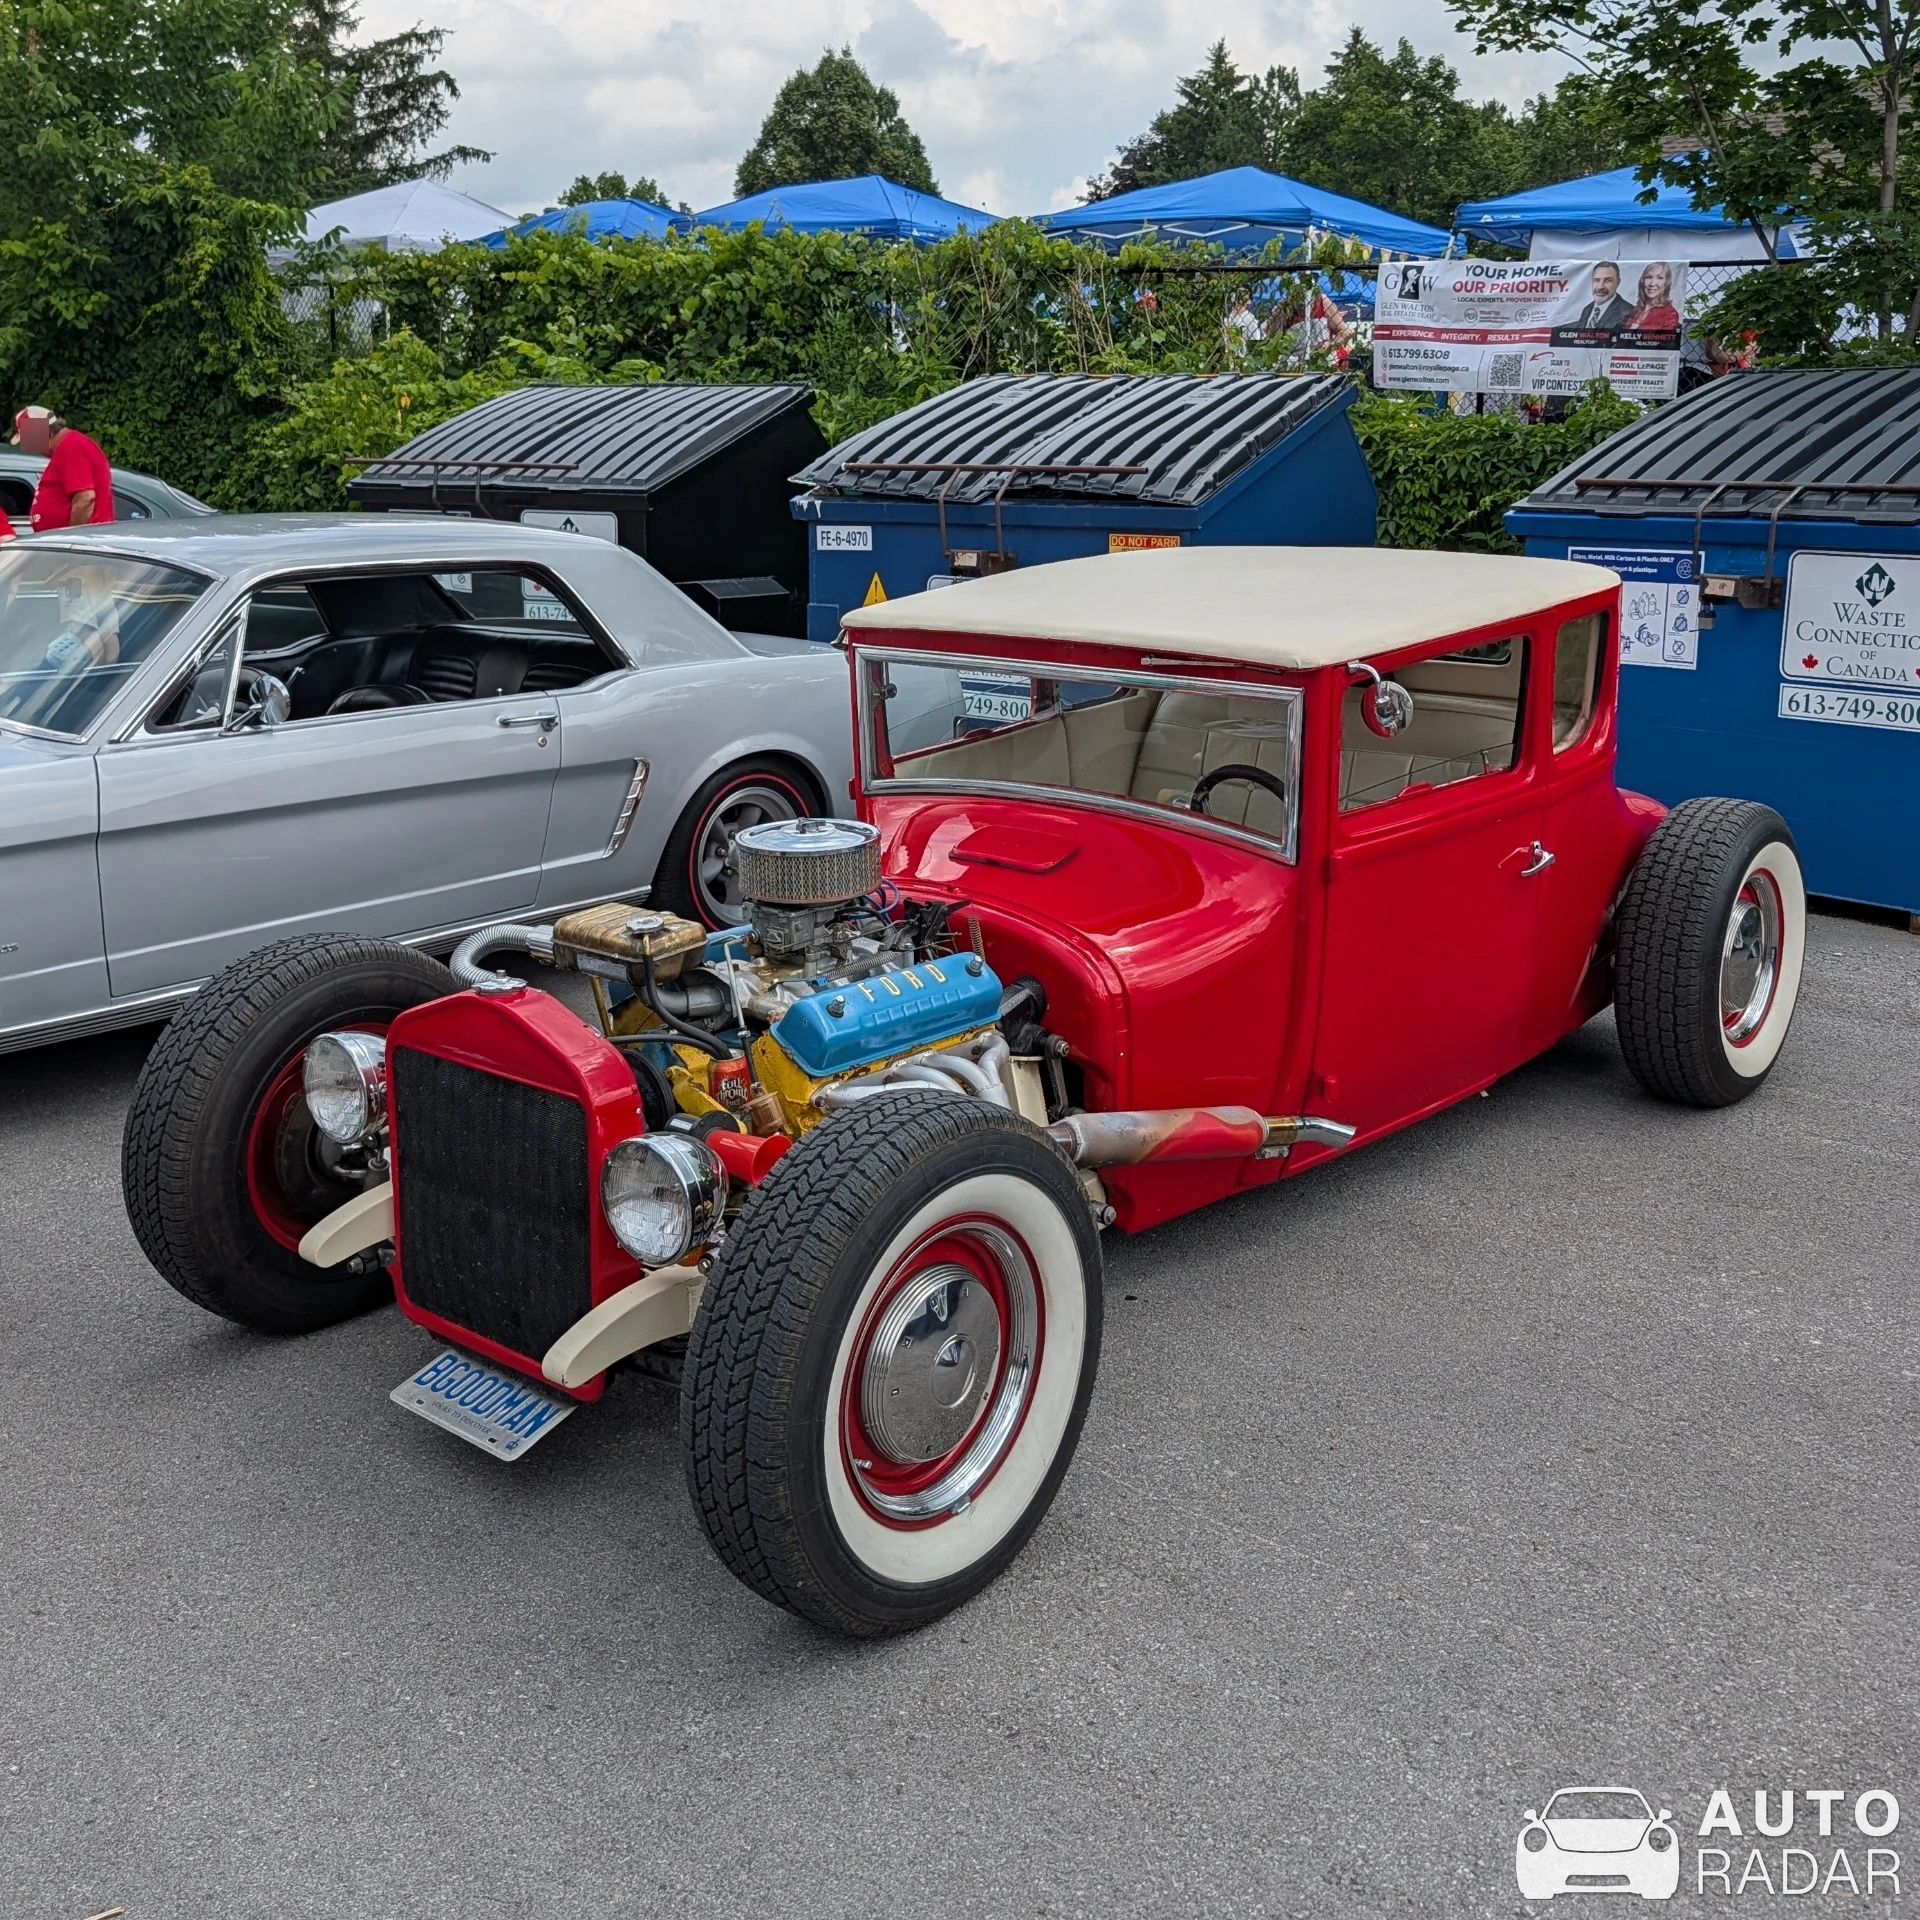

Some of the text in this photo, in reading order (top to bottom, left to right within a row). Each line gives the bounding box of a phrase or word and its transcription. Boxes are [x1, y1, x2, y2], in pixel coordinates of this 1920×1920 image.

[1465, 265, 1563, 280] YOUR HOME.
[1384, 272, 1439, 292] G W
[1452, 280, 1569, 293] OUR PRIORITY.
[1381, 302, 1435, 312] GLEN WALTON
[1441, 333, 1482, 341] INTEGRITY.
[1487, 333, 1520, 341] RESULTS
[1643, 333, 1677, 341] BENNETT
[1388, 348, 1450, 360] 613.799.6308
[1388, 375, 1450, 384] www.glenwalton.com
[1532, 379, 1545, 390] VIP
[820, 530, 868, 547] FE-6-4970
[1111, 536, 1178, 548] DO NOT PARK
[1832, 602, 1906, 628] WASTE
[1859, 650, 1877, 661] OF
[1826, 656, 1909, 682] CANADA
[857, 963, 947, 1003] FORD
[413, 1354, 563, 1439] BGOODMAN
[431, 1400, 492, 1434] YOURS TO DISCOVER
